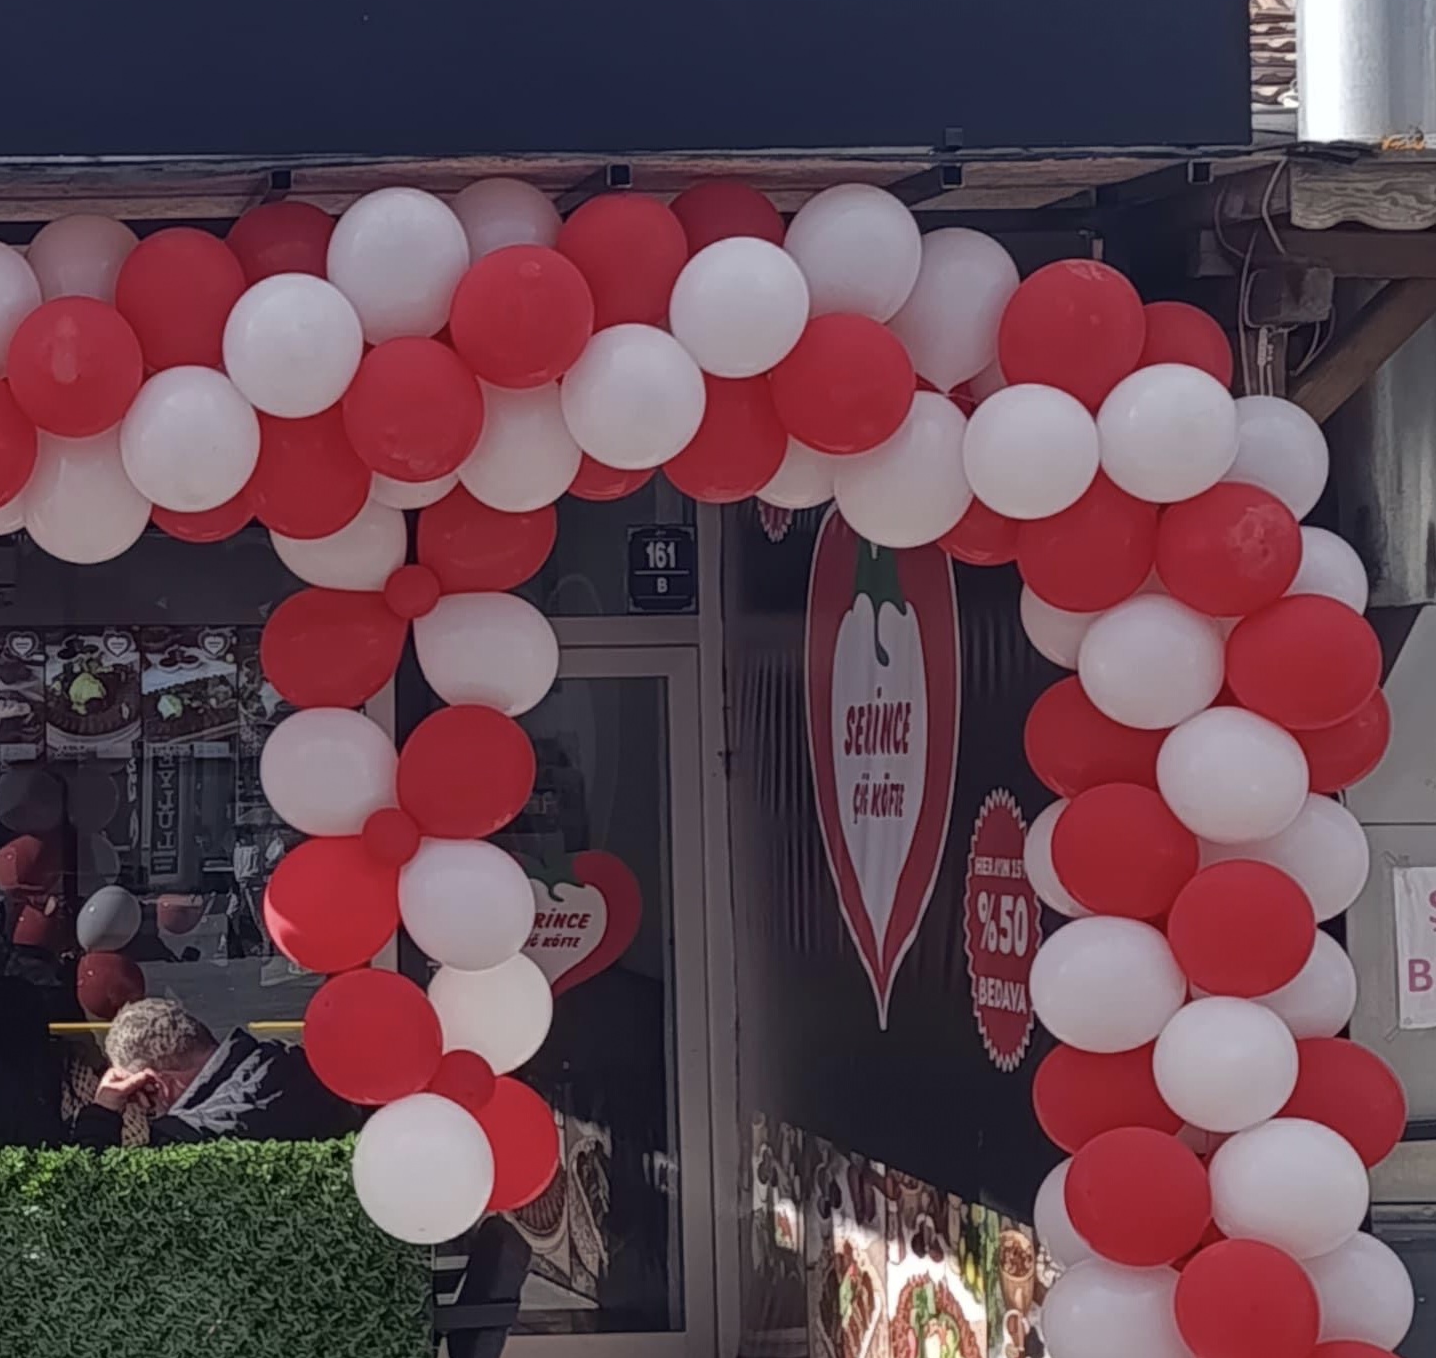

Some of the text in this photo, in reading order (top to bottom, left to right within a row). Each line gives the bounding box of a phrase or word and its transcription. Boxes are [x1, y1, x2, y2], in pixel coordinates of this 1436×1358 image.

[646, 541, 676, 569] 161
[657, 577, 668, 593] B
[844, 686, 911, 756] SERİNCE
[534, 907, 591, 929] RİNCE
[977, 891, 1029, 958] %50
[978, 976, 1028, 1015] BEDAVA
